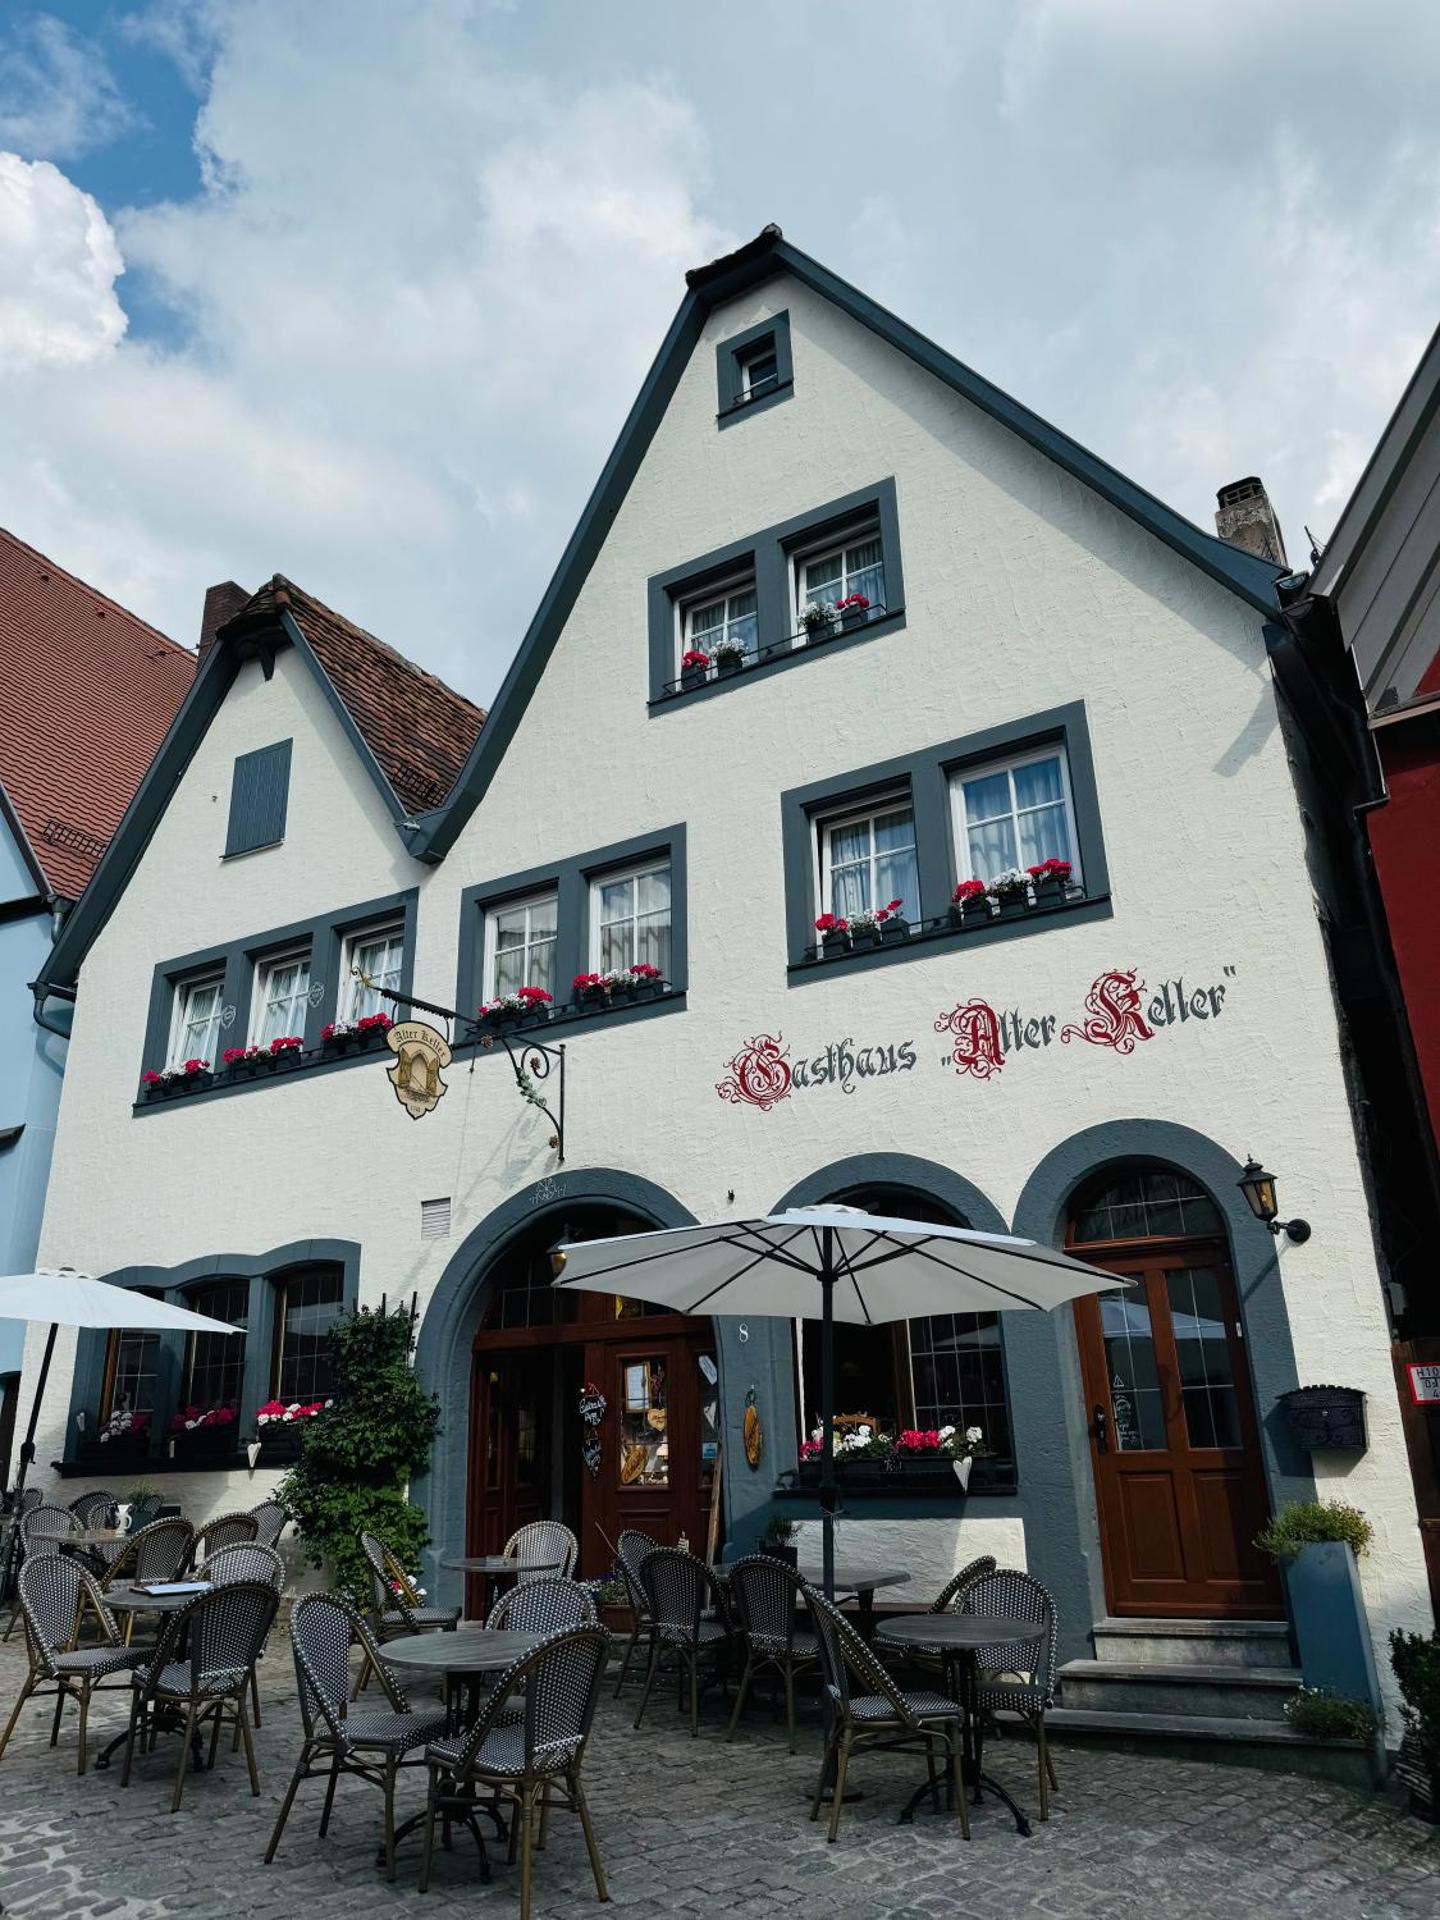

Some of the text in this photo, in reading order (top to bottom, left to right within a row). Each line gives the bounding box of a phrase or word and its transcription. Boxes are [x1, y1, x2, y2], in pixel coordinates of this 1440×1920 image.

[394, 1030, 445, 1057] Alter Keller
[715, 1030, 917, 1112] Gasthaus
[739, 1323, 749, 1343] 8
